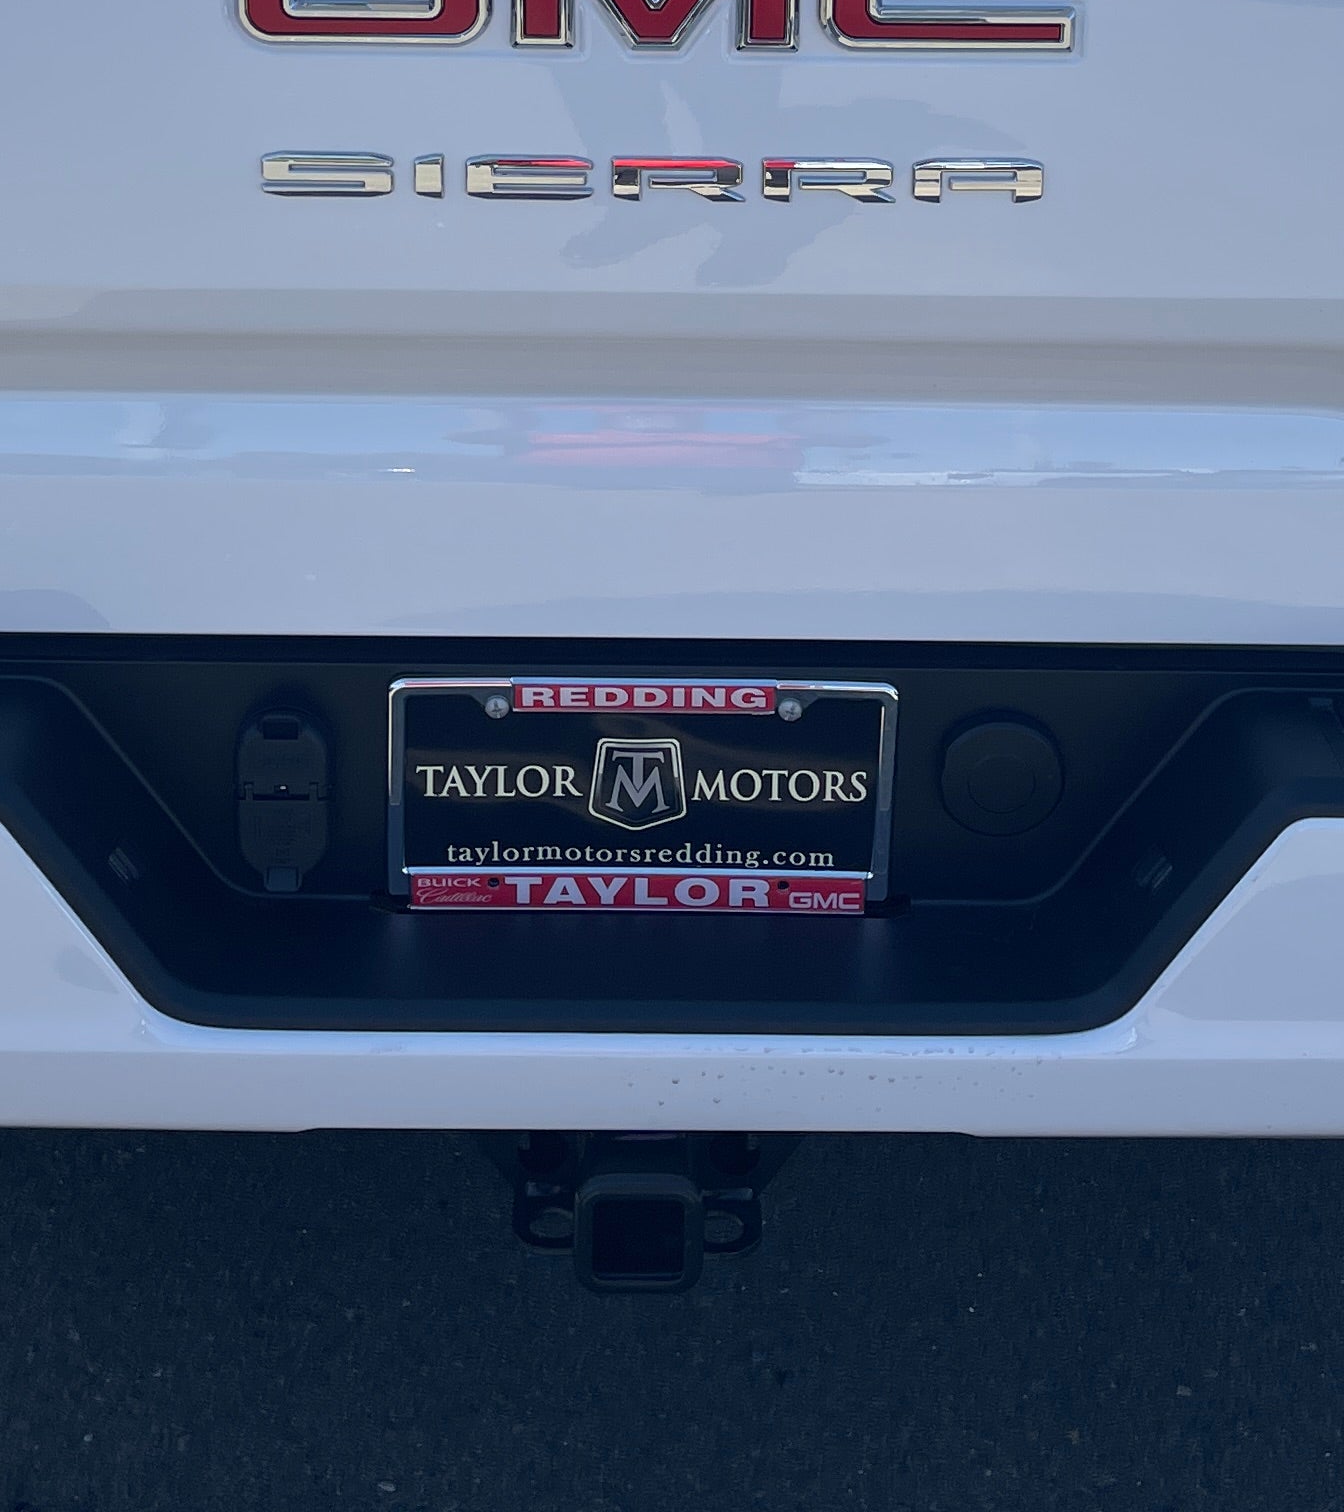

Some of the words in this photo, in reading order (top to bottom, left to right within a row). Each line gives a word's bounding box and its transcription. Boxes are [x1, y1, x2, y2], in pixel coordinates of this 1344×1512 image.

[261, 151, 1045, 203] SIERRA
[521, 687, 767, 708] REDDING
[415, 764, 584, 798] TAYLOR
[690, 768, 868, 803] MOTORS
[446, 841, 835, 868] taylormotorsredding.com
[417, 877, 483, 888] BUICK
[504, 876, 771, 908] TAYLOR
[416, 888, 492, 904] Cadillac
[788, 891, 861, 910] GMC
